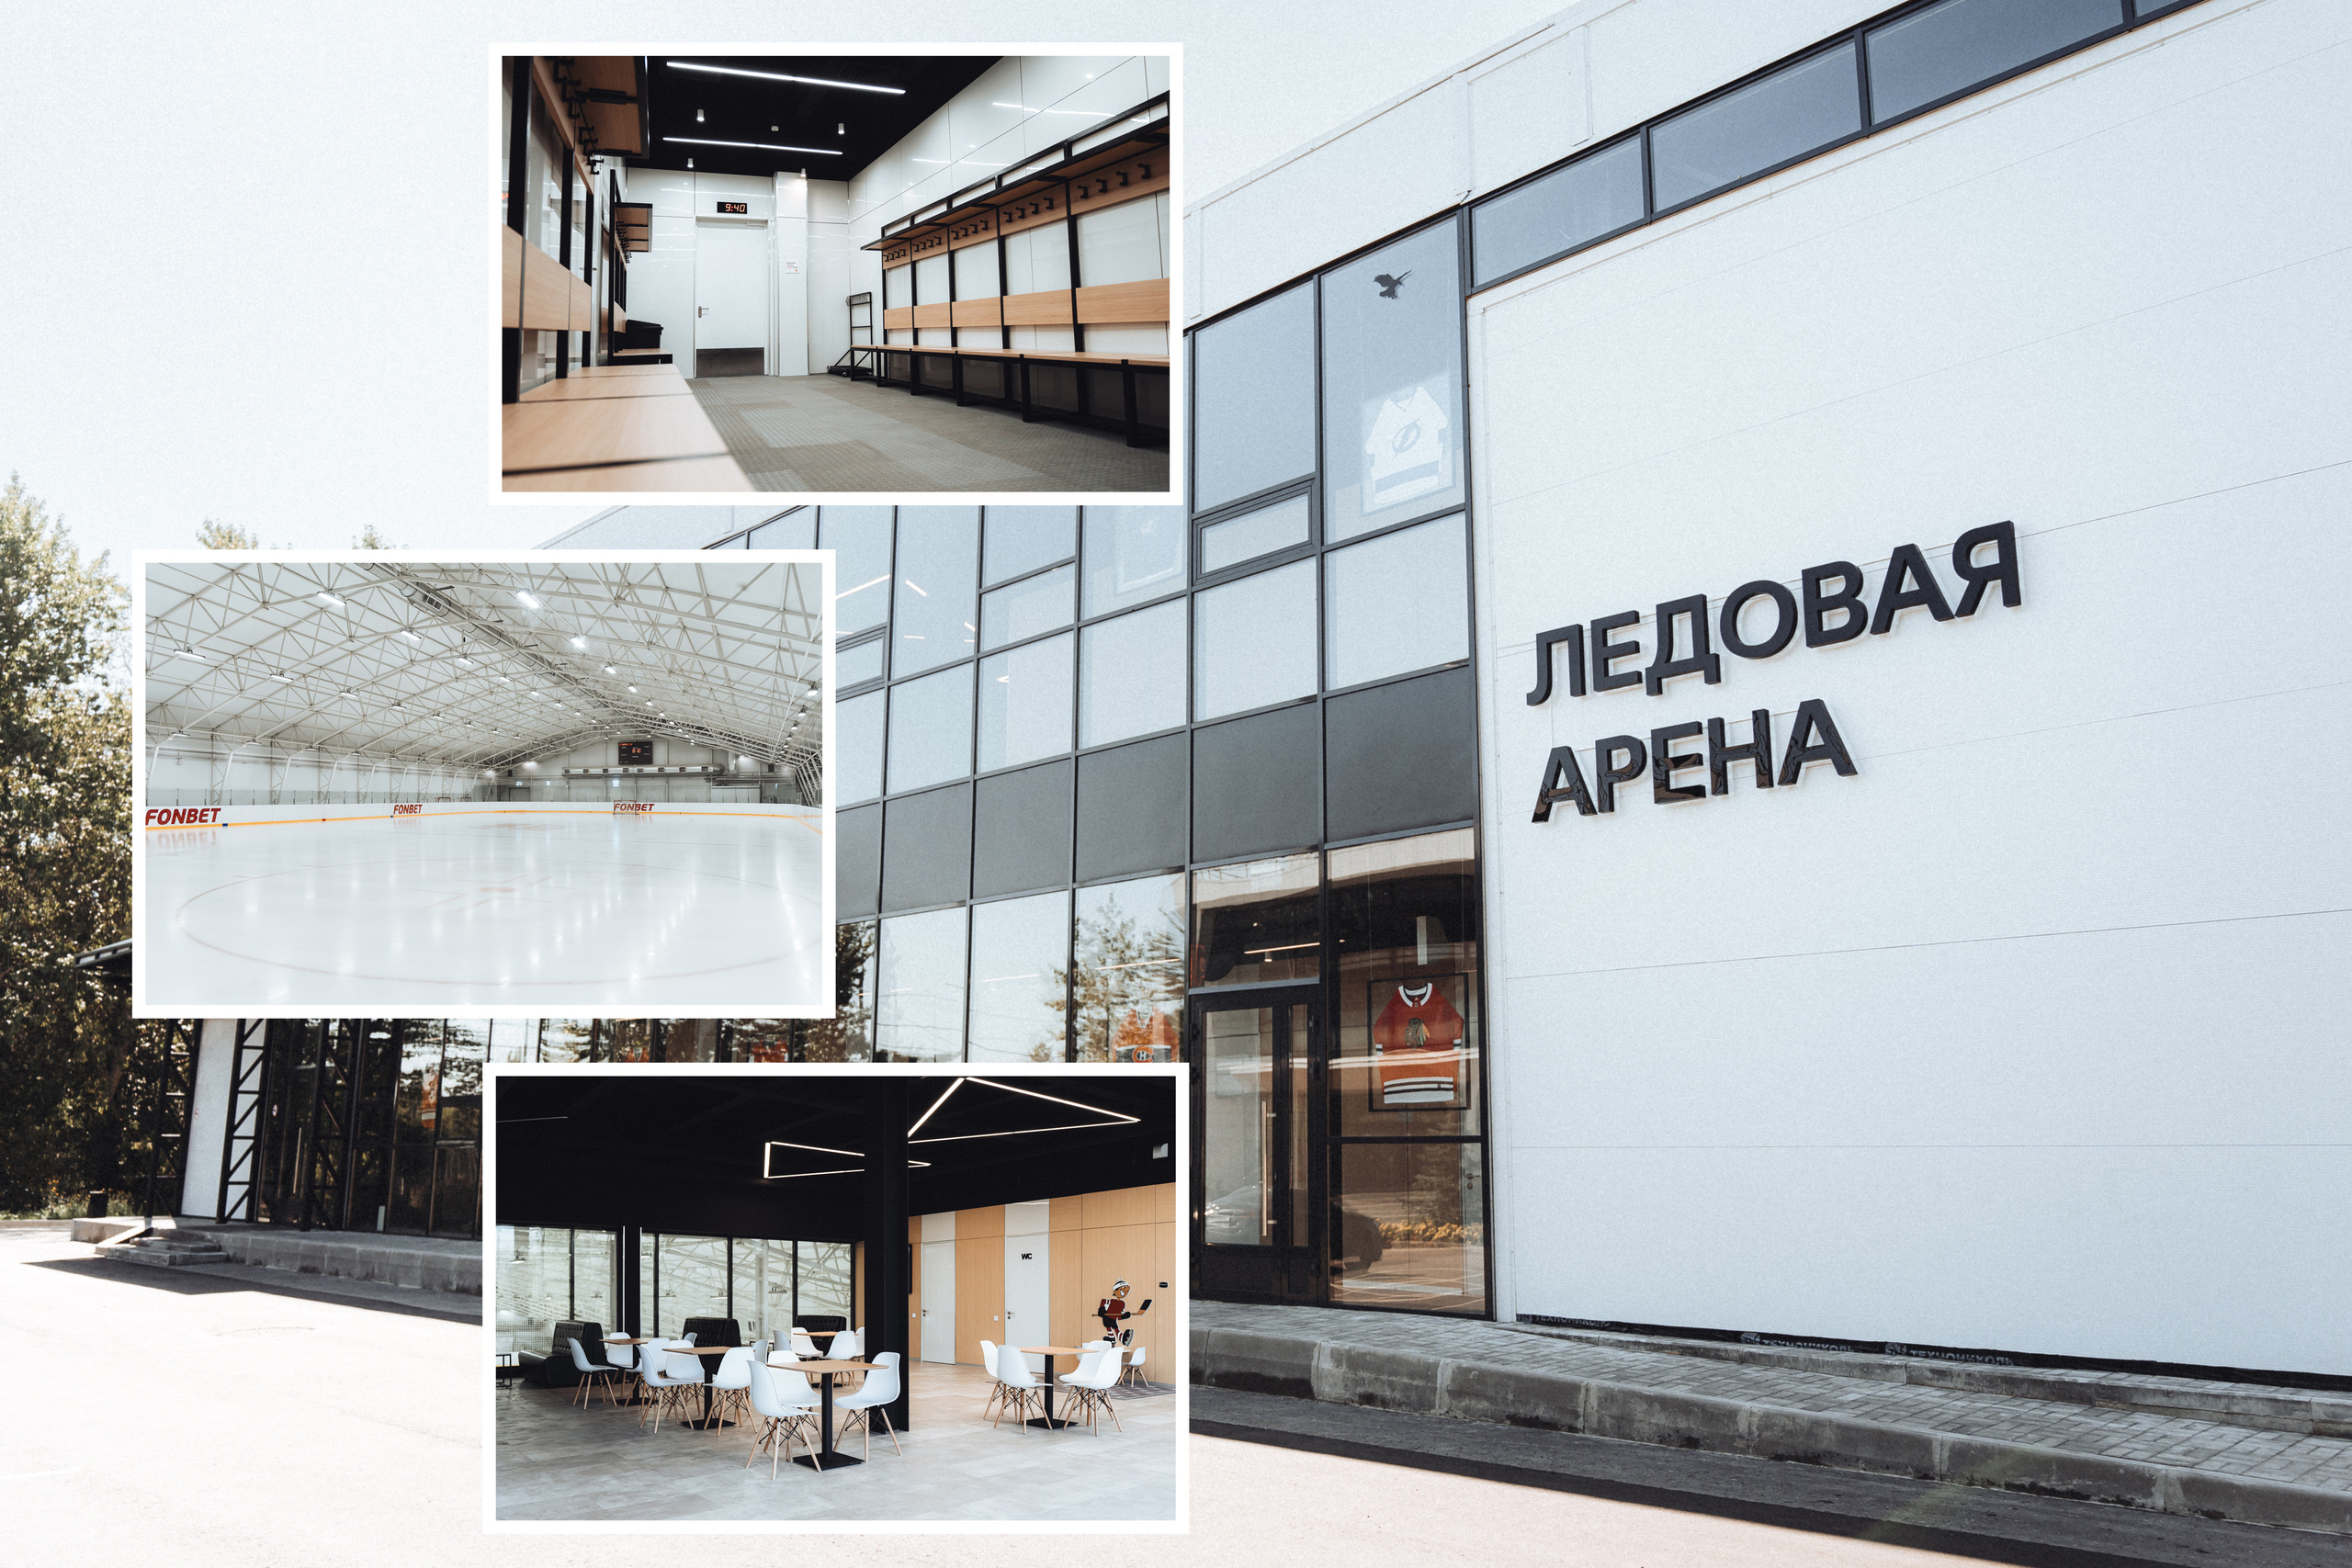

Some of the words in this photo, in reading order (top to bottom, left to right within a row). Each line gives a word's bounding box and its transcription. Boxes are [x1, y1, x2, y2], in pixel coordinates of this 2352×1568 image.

[725, 203, 746, 213] 9:40
[1526, 520, 2021, 706] ЛЕДОВАЯ
[1532, 698, 1859, 823] АРЕНА
[393, 804, 423, 815] FONBET
[615, 803, 655, 812] FONBET
[145, 808, 221, 826] FONBET
[1021, 1252, 1033, 1260] WC
